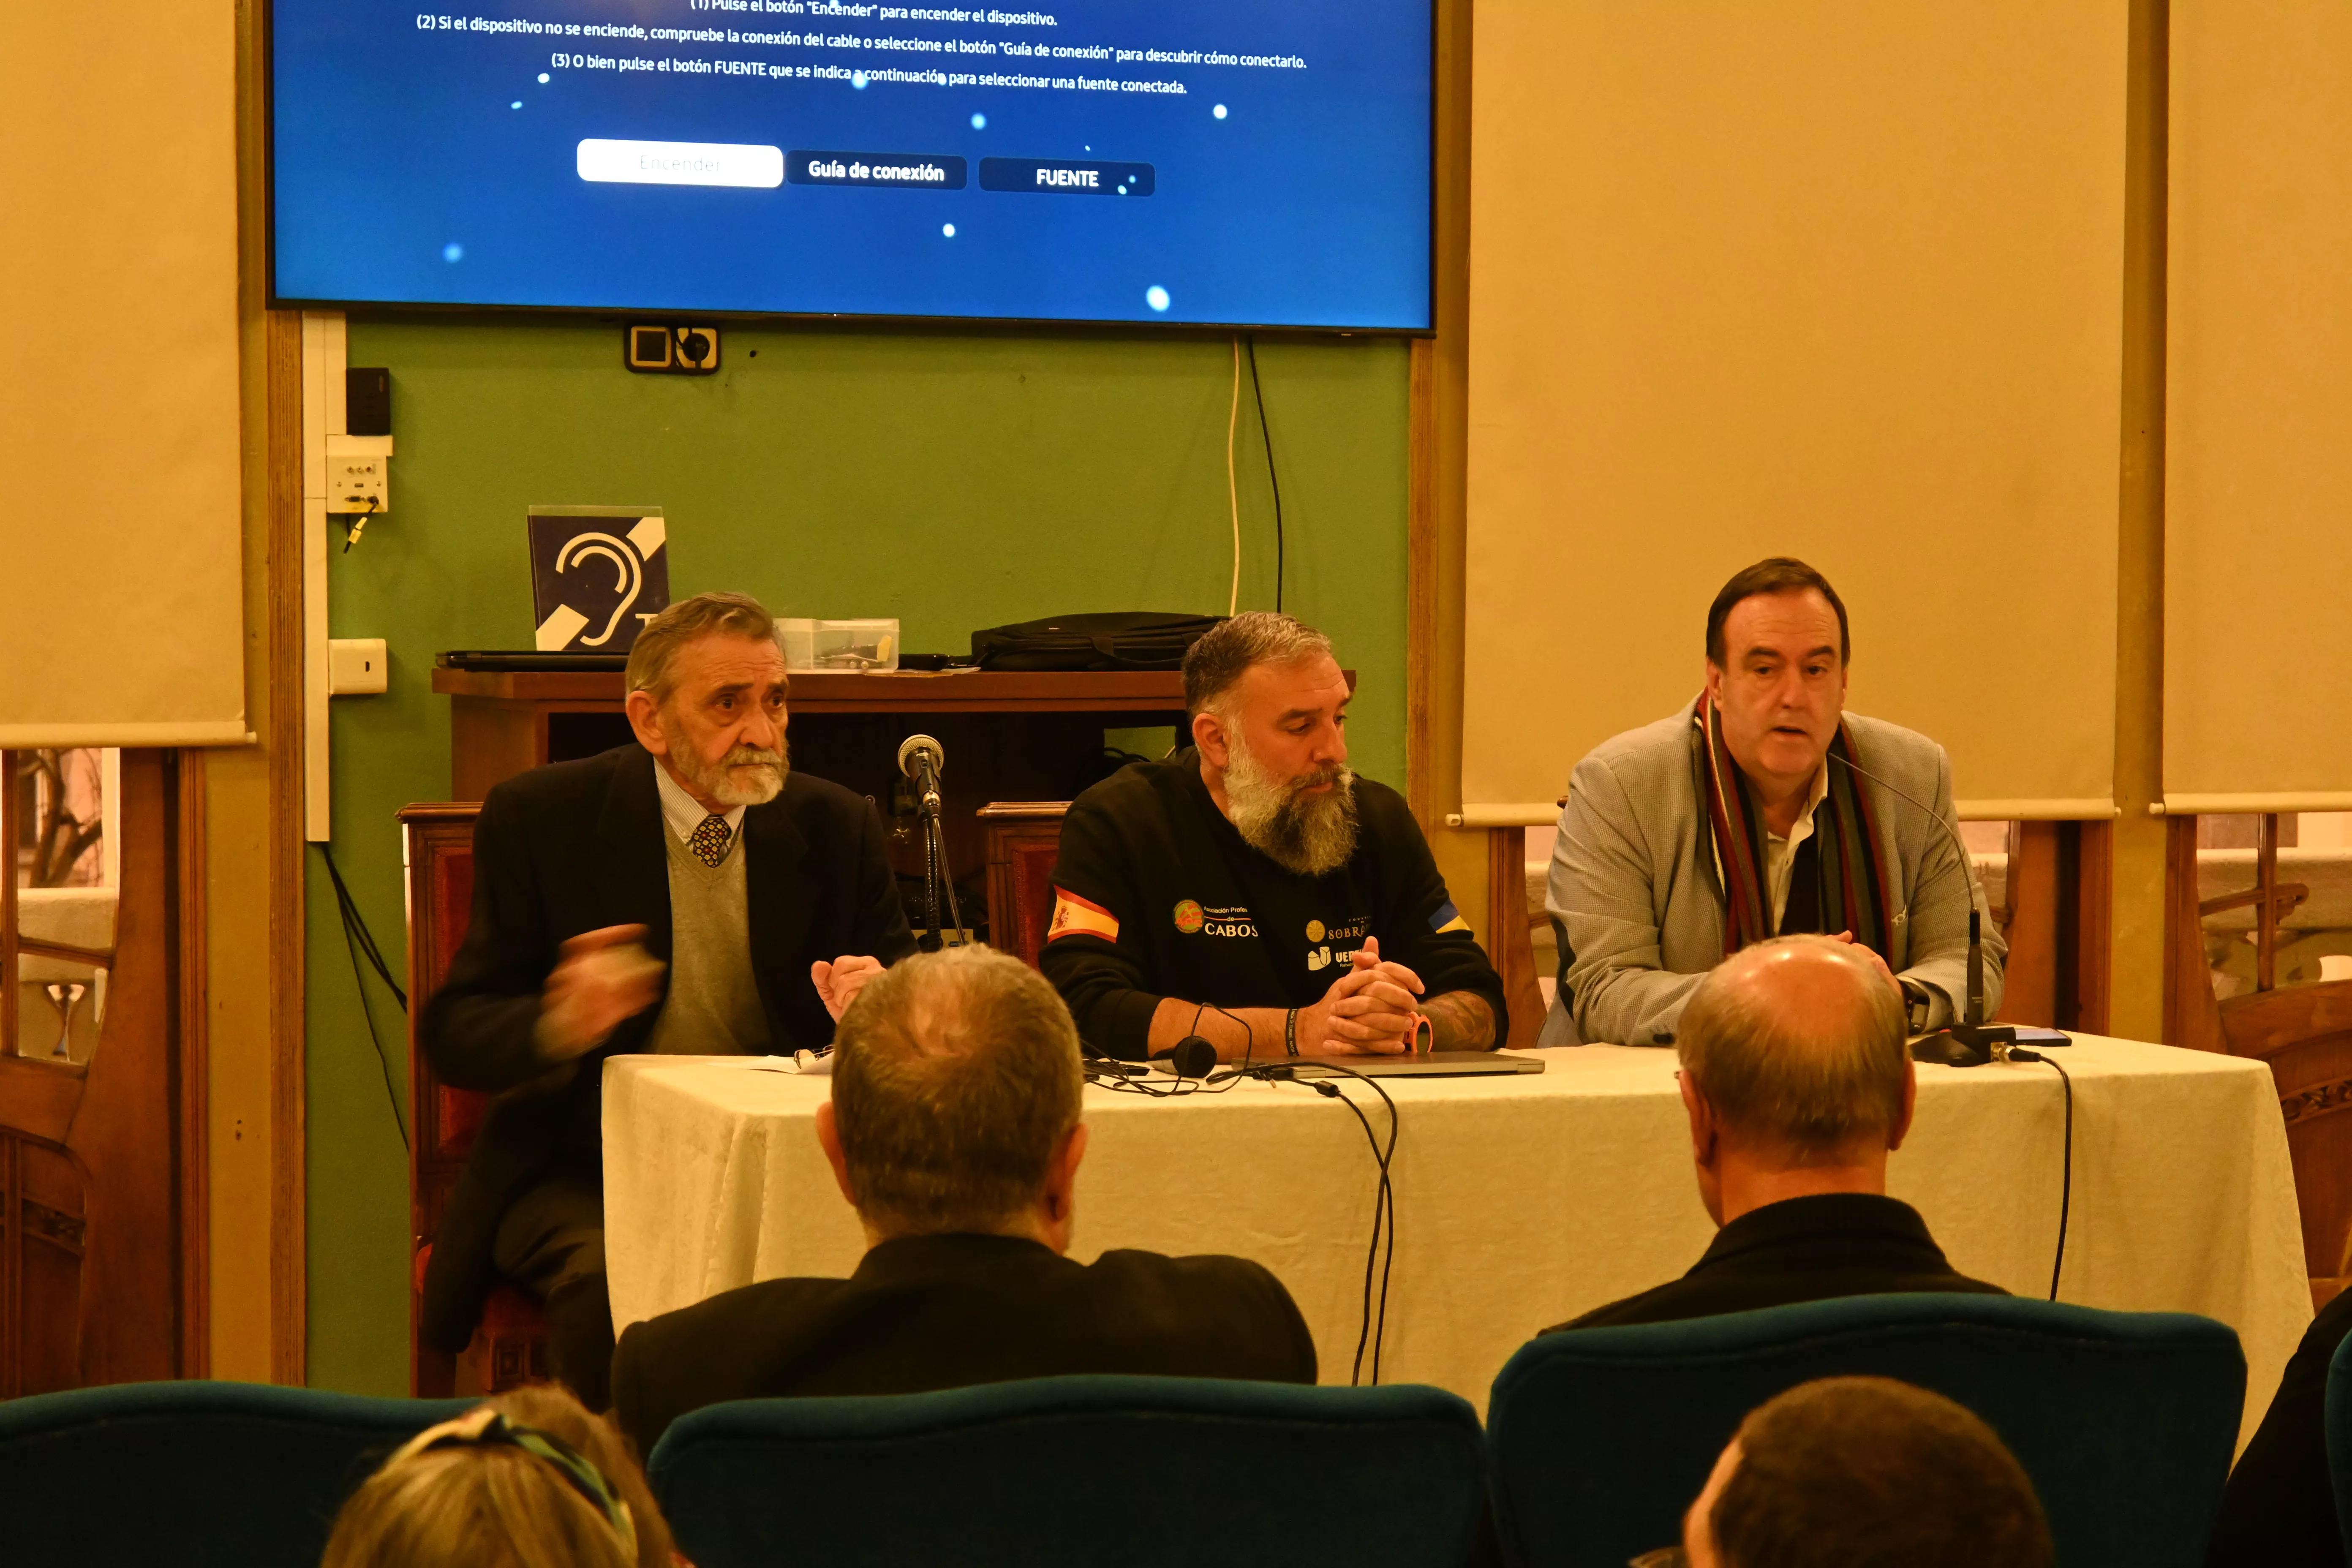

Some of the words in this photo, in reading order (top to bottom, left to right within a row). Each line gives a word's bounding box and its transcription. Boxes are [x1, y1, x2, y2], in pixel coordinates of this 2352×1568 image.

[690, 0, 709, 10] (1)
[711, 0, 748, 11] Pulse
[750, 0, 763, 12] el
[766, 0, 804, 14] botón
[807, 1, 878, 17] "Encender"
[880, 7, 908, 20] para
[910, 7, 971, 21] encender
[972, 9, 985, 22] el
[987, 9, 1057, 26] dispositivo.
[416, 14, 436, 30] (2)
[438, 16, 451, 29] Si
[454, 16, 468, 30] el
[470, 17, 542, 35] dispositivo
[545, 23, 563, 35] no
[565, 24, 581, 35] se
[583, 23, 648, 41] enciende,
[650, 27, 724, 43] compruebe
[727, 29, 739, 42] la
[742, 31, 800, 45] conexión
[803, 33, 824, 46] del
[827, 34, 861, 48] cable
[863, 38, 872, 49] o
[874, 36, 942, 52] seleccione
[944, 39, 957, 52] el
[960, 39, 996, 54] botón
[999, 41, 1032, 56] "Guía
[1034, 43, 1050, 57] de
[1052, 45, 1114, 59] conexión"
[1116, 50, 1143, 63] para
[1146, 48, 1203, 63] descubrir
[1204, 50, 1238, 65] cómo
[1240, 55, 1307, 68] conectarlo.
[551, 53, 570, 68] (3)
[573, 54, 584, 68] O
[587, 54, 615, 69] bien
[619, 57, 655, 72] pulse
[657, 58, 670, 71] el
[673, 58, 711, 73] botón
[715, 60, 767, 76] FUENTE
[769, 65, 793, 79] que
[795, 67, 811, 77] se
[814, 64, 851, 79] indica
[864, 68, 947, 84] continuación
[949, 74, 976, 87] para
[979, 72, 1051, 87] seleccionar
[1052, 78, 1075, 89] una
[1077, 76, 1119, 91] fuente
[1121, 80, 1187, 94] conectada.
[640, 155, 720, 172] Encender
[808, 160, 846, 177] Guía
[849, 161, 870, 178] de
[872, 163, 944, 181] conexión
[1037, 169, 1099, 187] FUENTE
[1203, 906, 1229, 914] Asociación
[1205, 923, 1258, 937] CABOS
